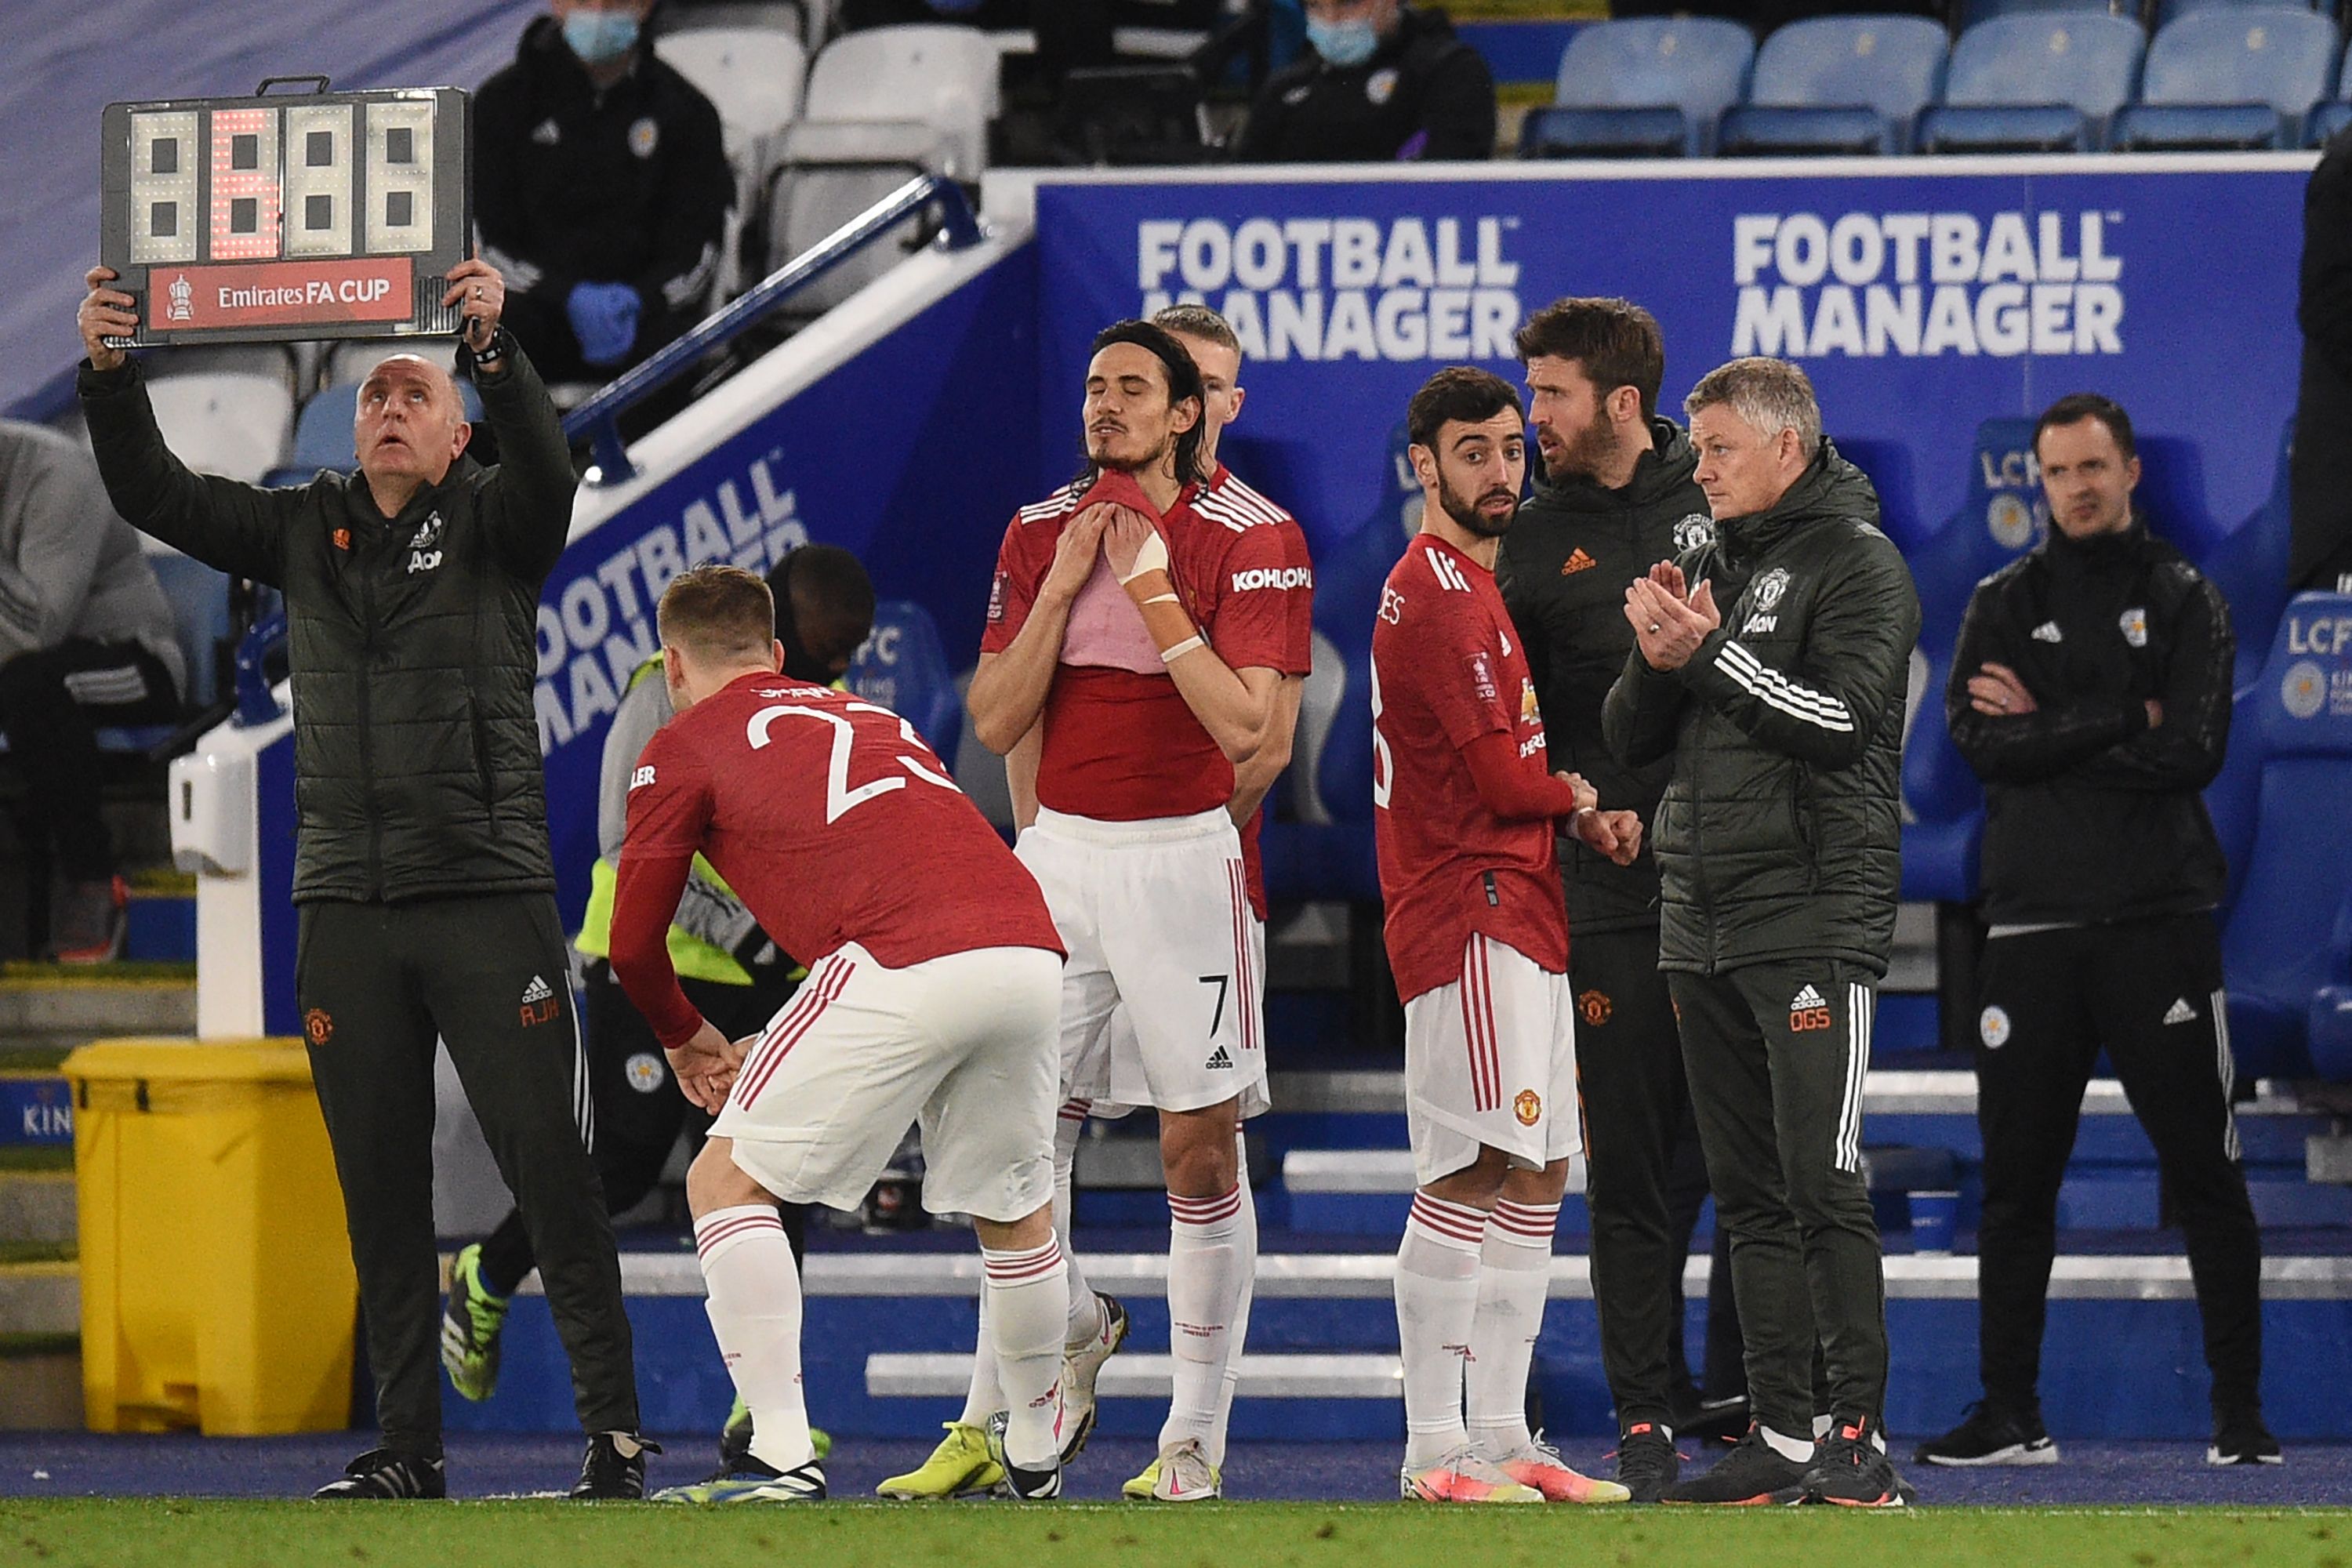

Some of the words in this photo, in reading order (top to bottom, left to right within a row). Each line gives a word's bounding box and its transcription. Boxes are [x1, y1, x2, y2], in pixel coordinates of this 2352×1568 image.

[1137, 217, 1519, 290] FOOTBALL
[1733, 210, 2122, 285] FOOTBALL
[218, 285, 303, 308] Emirates
[306, 280, 336, 304] FA
[339, 278, 390, 303] CUP
[1731, 283, 2123, 358] MANAGER
[536, 459, 797, 678] OOTBALL
[1232, 568, 1287, 593] KOHL
[2288, 616, 2352, 655] LCF
[1198, 975, 1229, 1040] 7
[1791, 998, 1826, 1011] adidas
[24, 1104, 73, 1137] KIN
